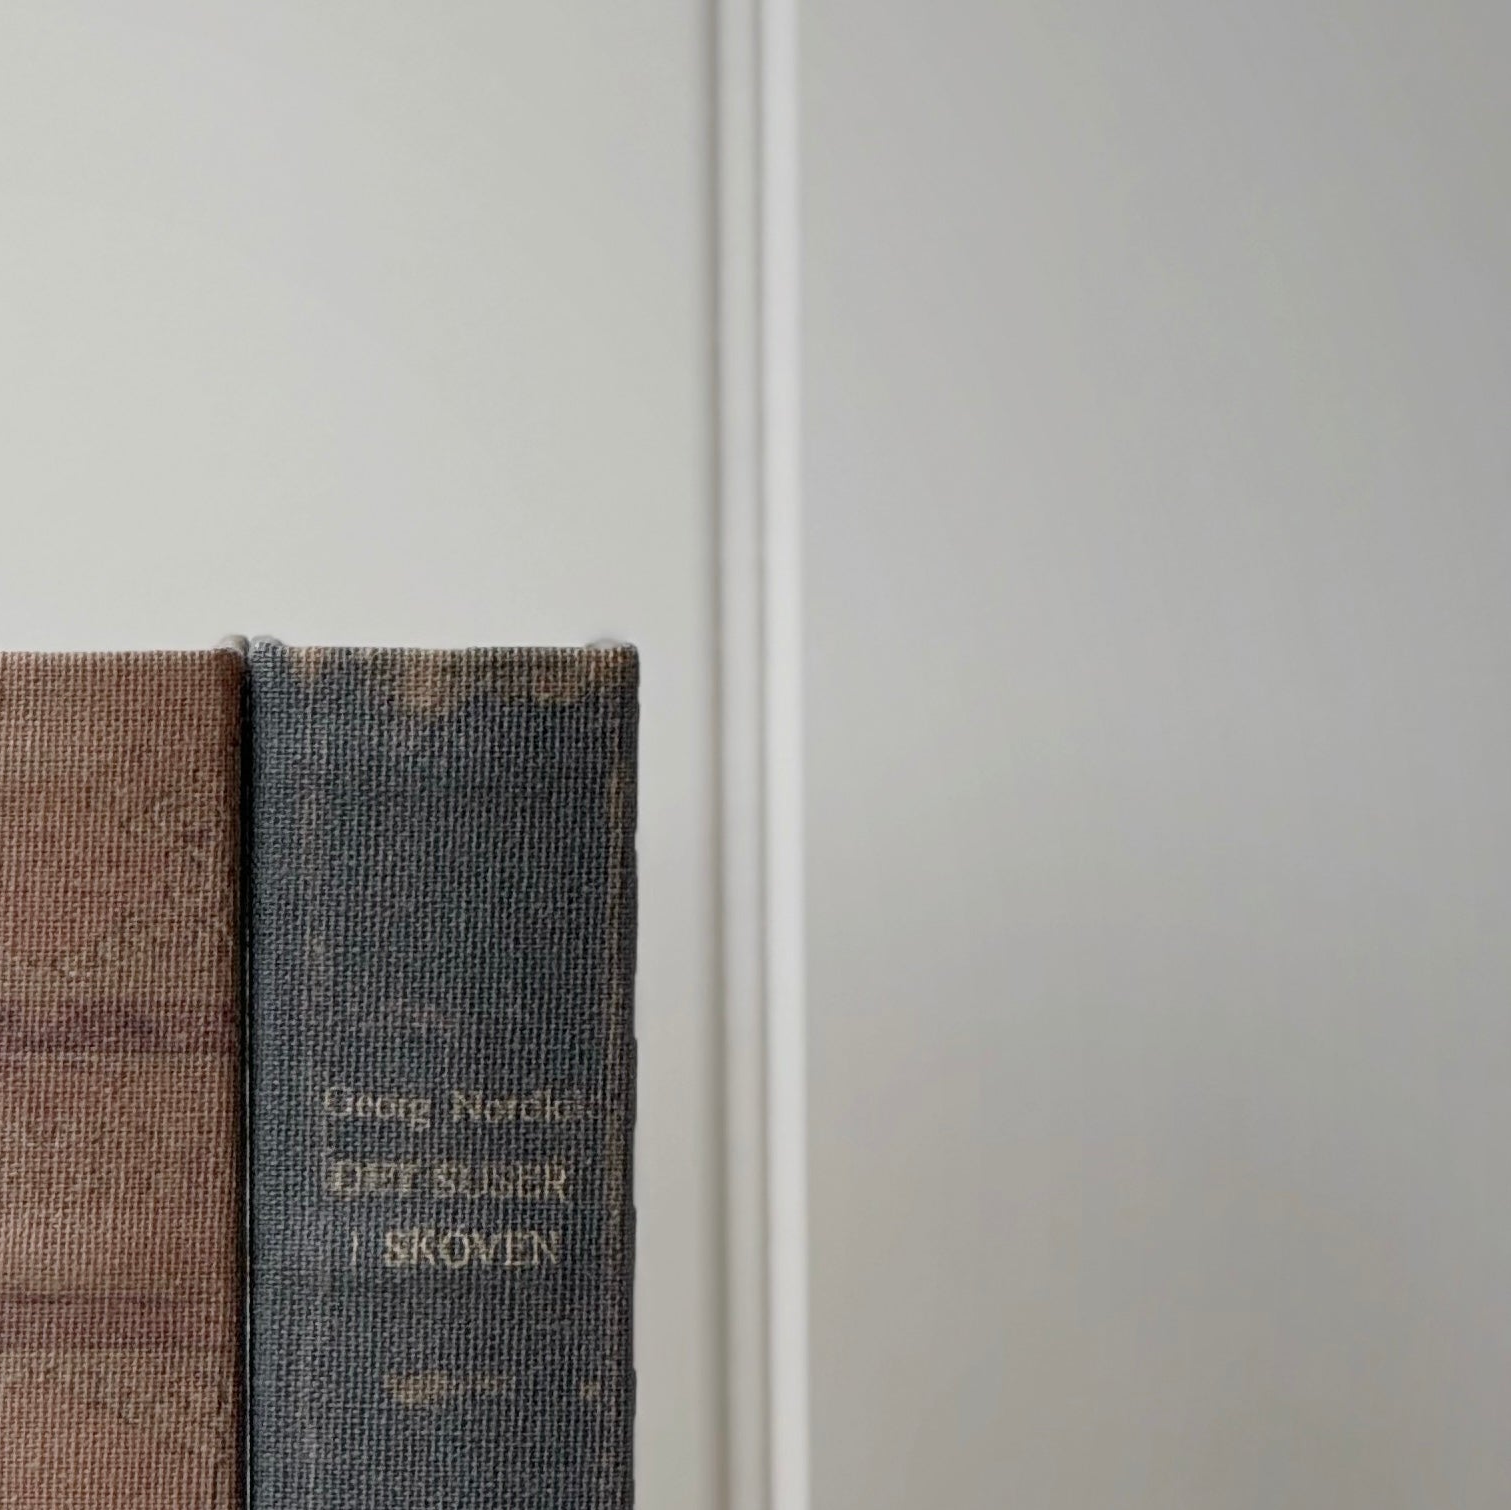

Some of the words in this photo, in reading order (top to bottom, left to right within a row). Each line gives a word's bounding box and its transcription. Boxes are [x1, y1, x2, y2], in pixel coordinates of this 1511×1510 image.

[323, 1085, 433, 1132] Georg
[330, 1159, 419, 1198] DET
[383, 1228, 561, 1269] SKOVEN
